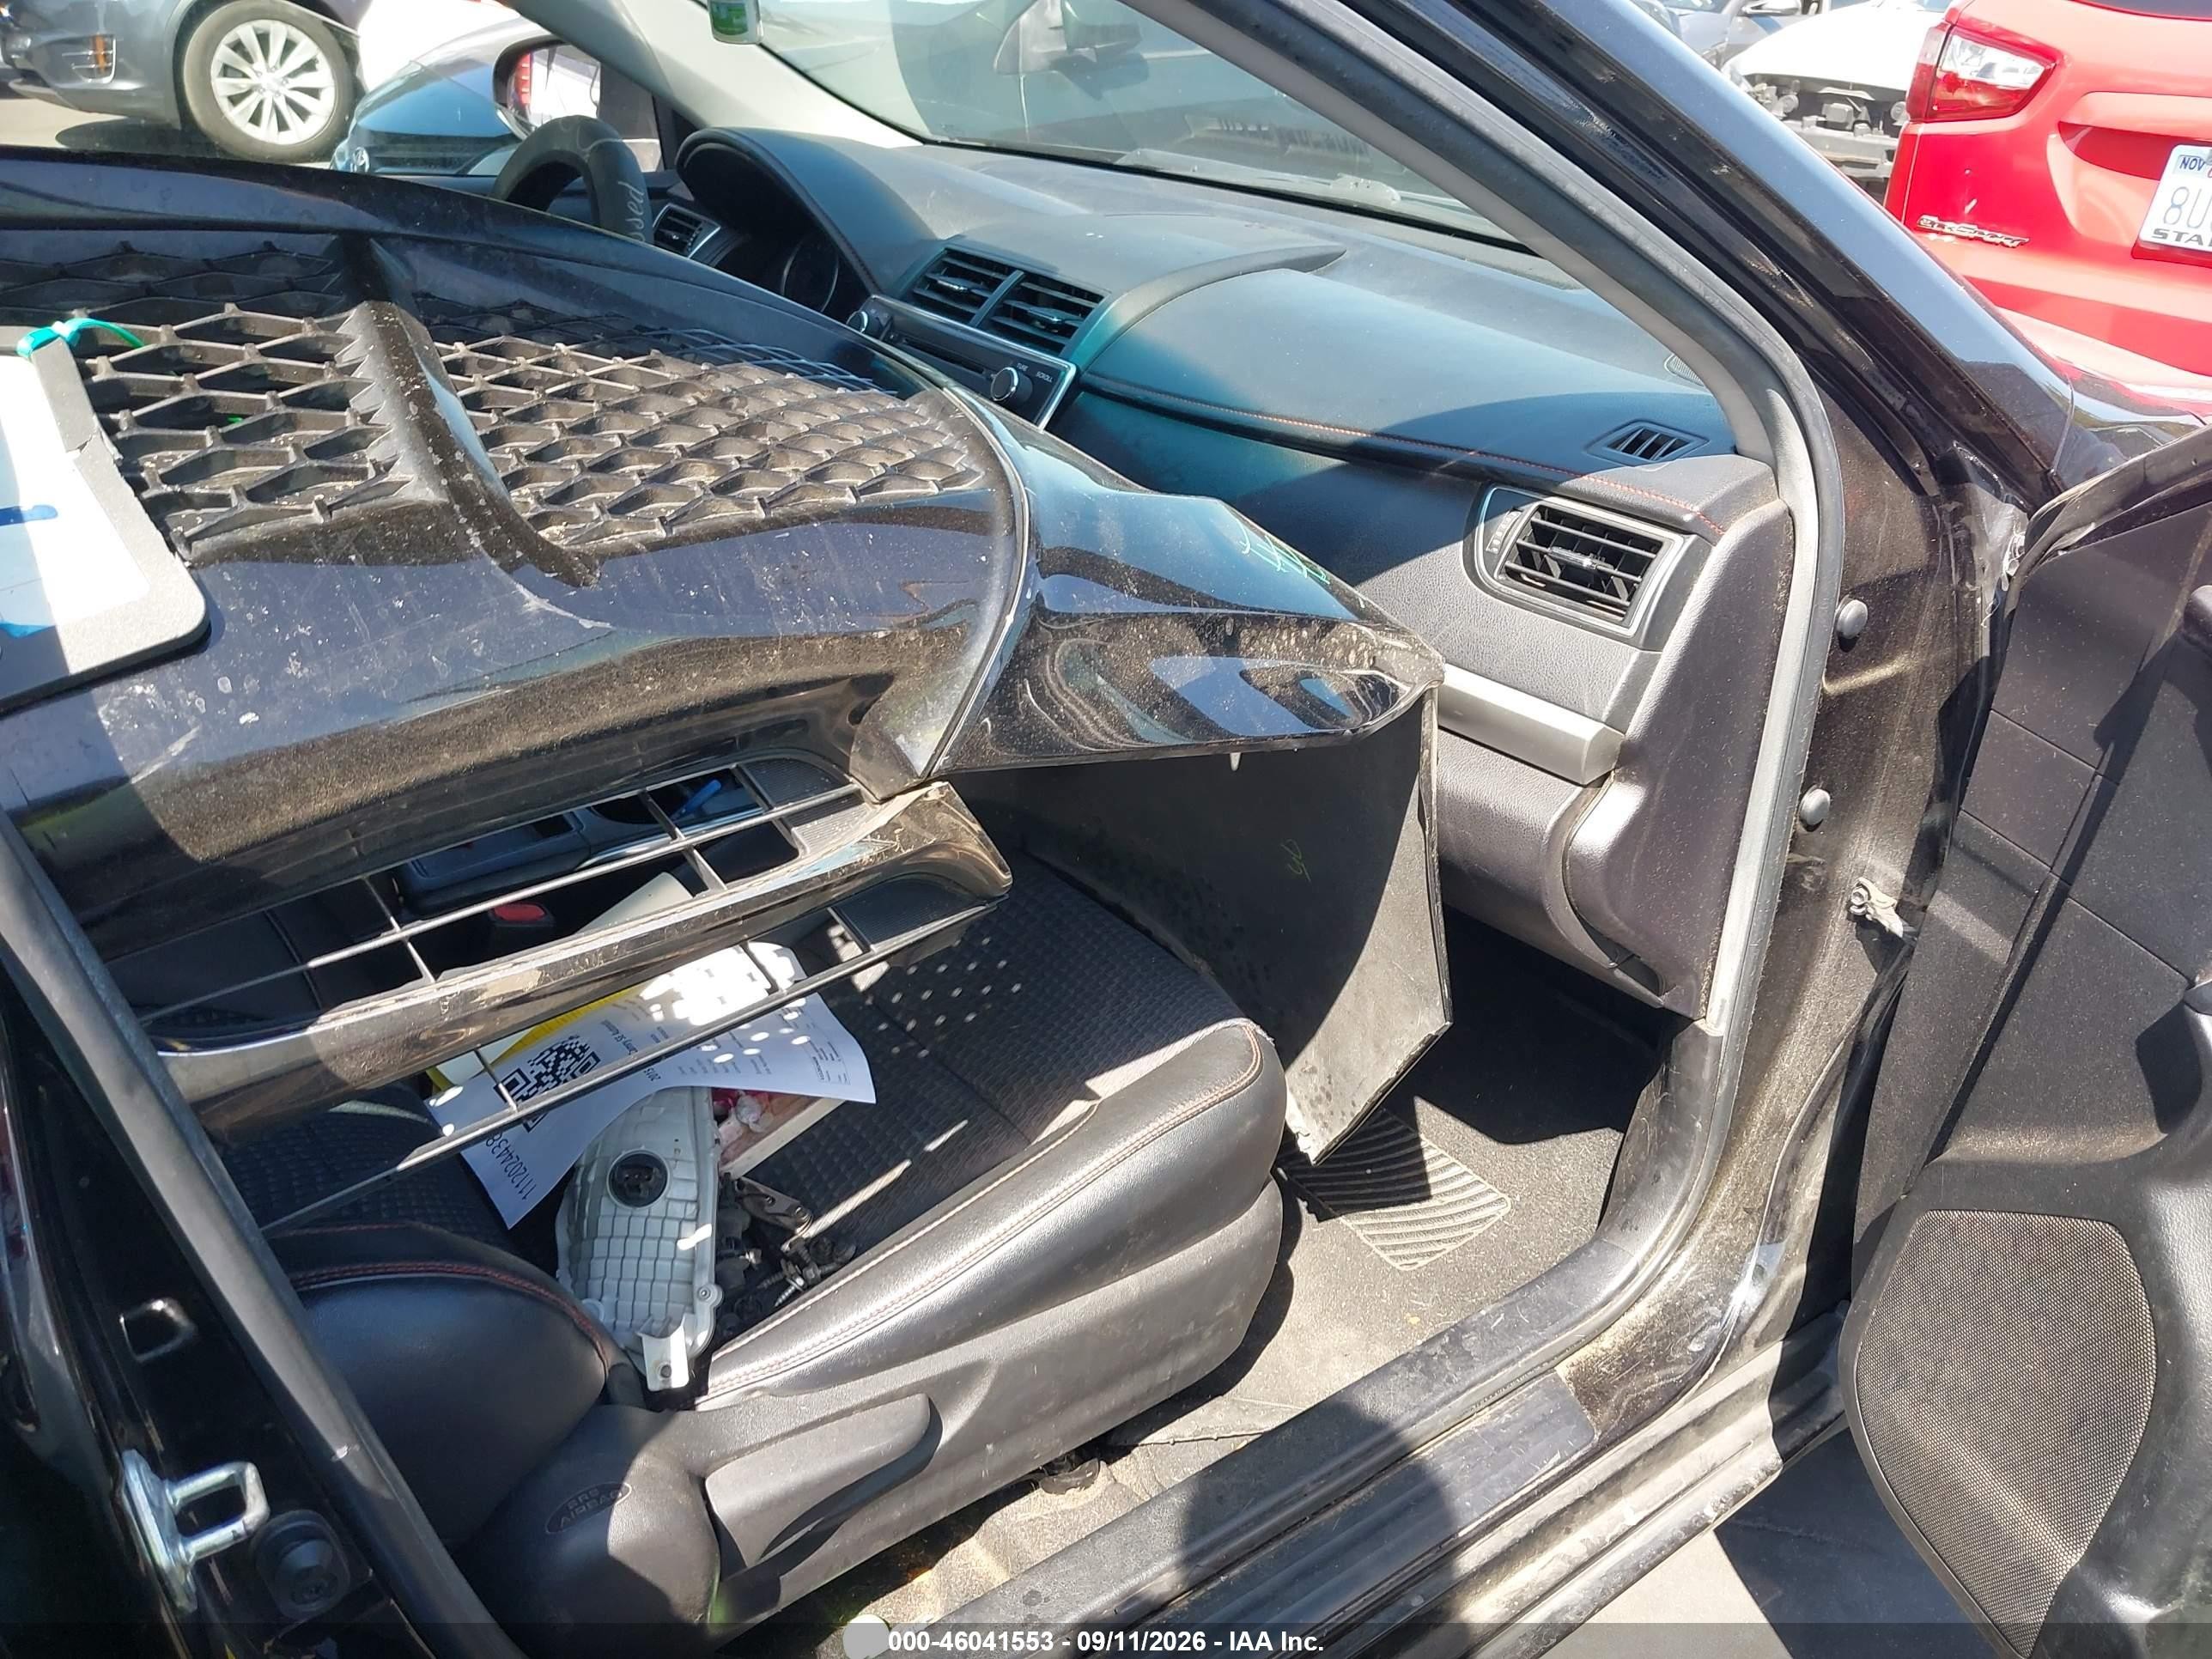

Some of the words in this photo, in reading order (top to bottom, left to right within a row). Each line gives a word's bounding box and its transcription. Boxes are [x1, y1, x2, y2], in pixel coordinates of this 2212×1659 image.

[2179, 156, 2205, 172] NOV
[2162, 185, 2212, 229] 8U
[1036, 371, 1053, 383] SCROLL
